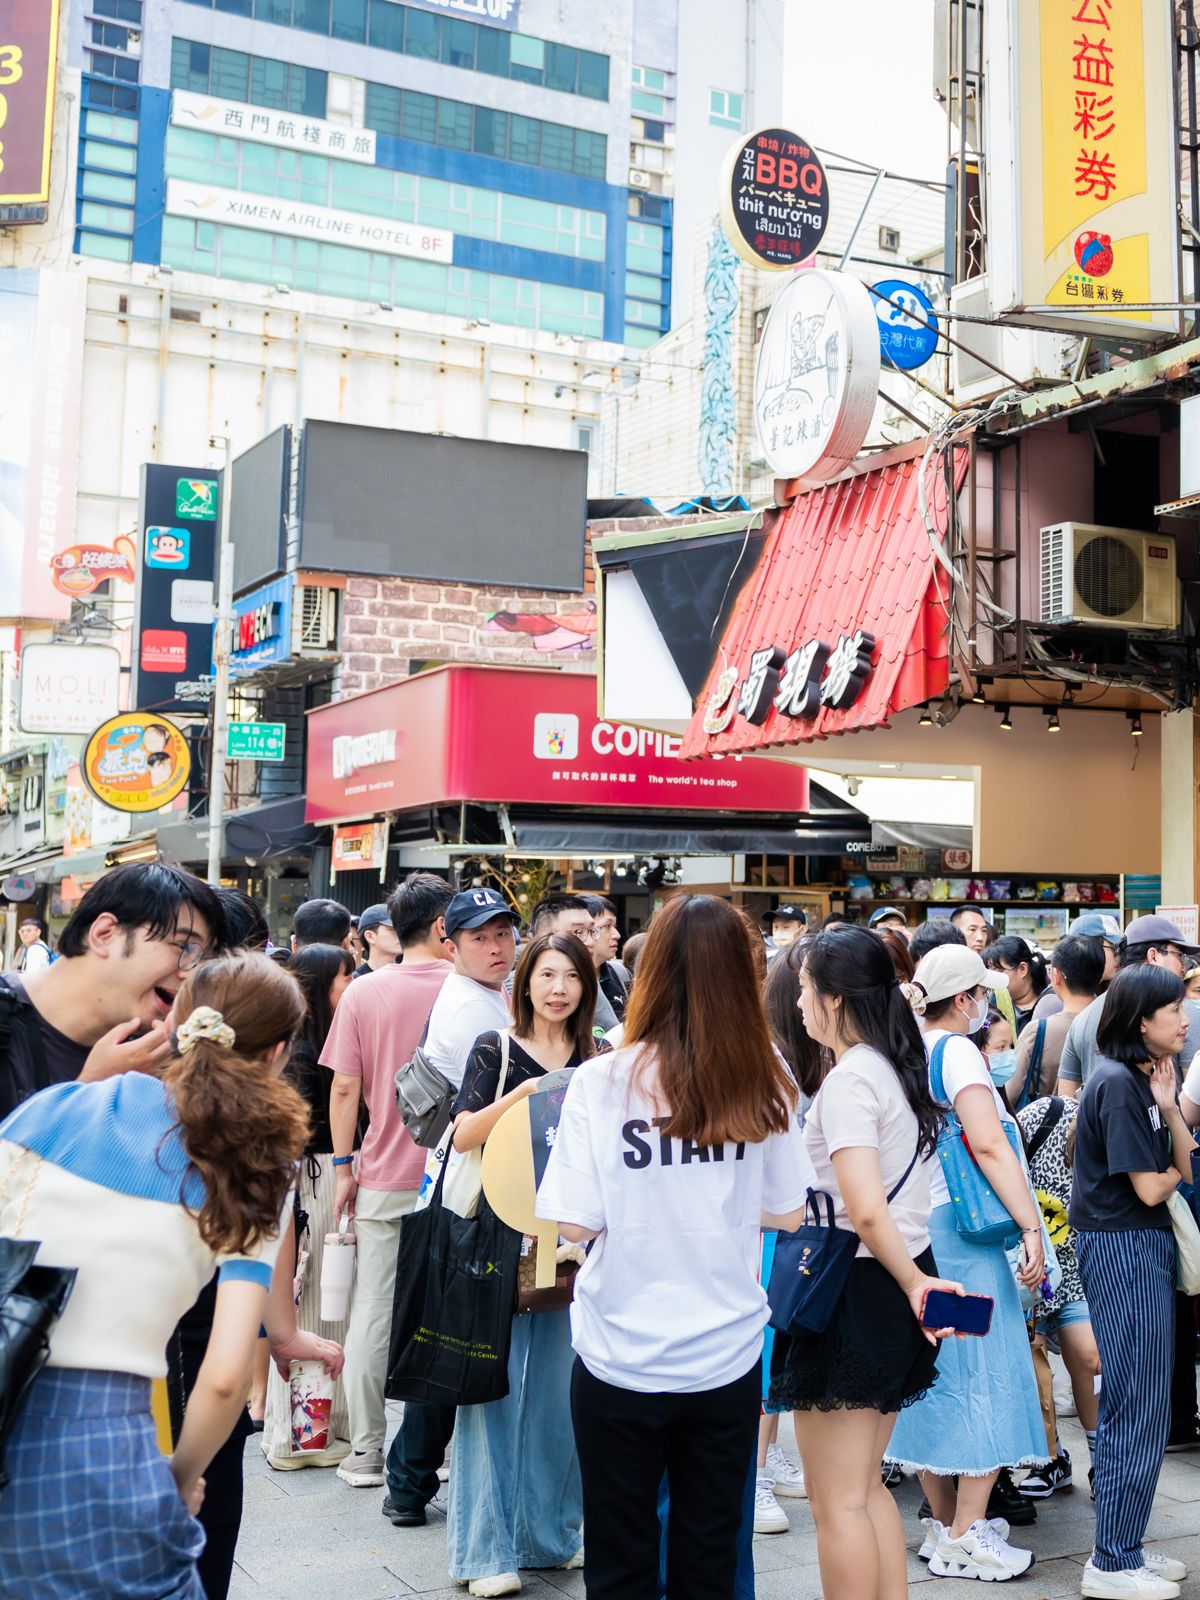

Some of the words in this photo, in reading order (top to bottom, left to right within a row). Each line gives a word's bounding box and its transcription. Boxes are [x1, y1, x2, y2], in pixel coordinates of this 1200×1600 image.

[1071, 0, 1117, 200] 公益彩券
[224, 108, 372, 155] 西門航棧商旅
[756, 152, 822, 196] BBQ
[739, 184, 821, 209] バーベキュー
[226, 200, 282, 221] XIMEN
[286, 212, 354, 235] AIRLINE
[360, 225, 413, 246] HOTEL
[420, 236, 442, 251] 8F
[1066, 281, 1124, 302] 台灣彩券
[35, 675, 106, 695] MOLI
[648, 775, 664, 784] The
[666, 776, 697, 786] world's
[700, 777, 714, 787] tea
[717, 778, 738, 788] shop
[473, 891, 497, 906] CA
[477, 1351, 498, 1360] Center
